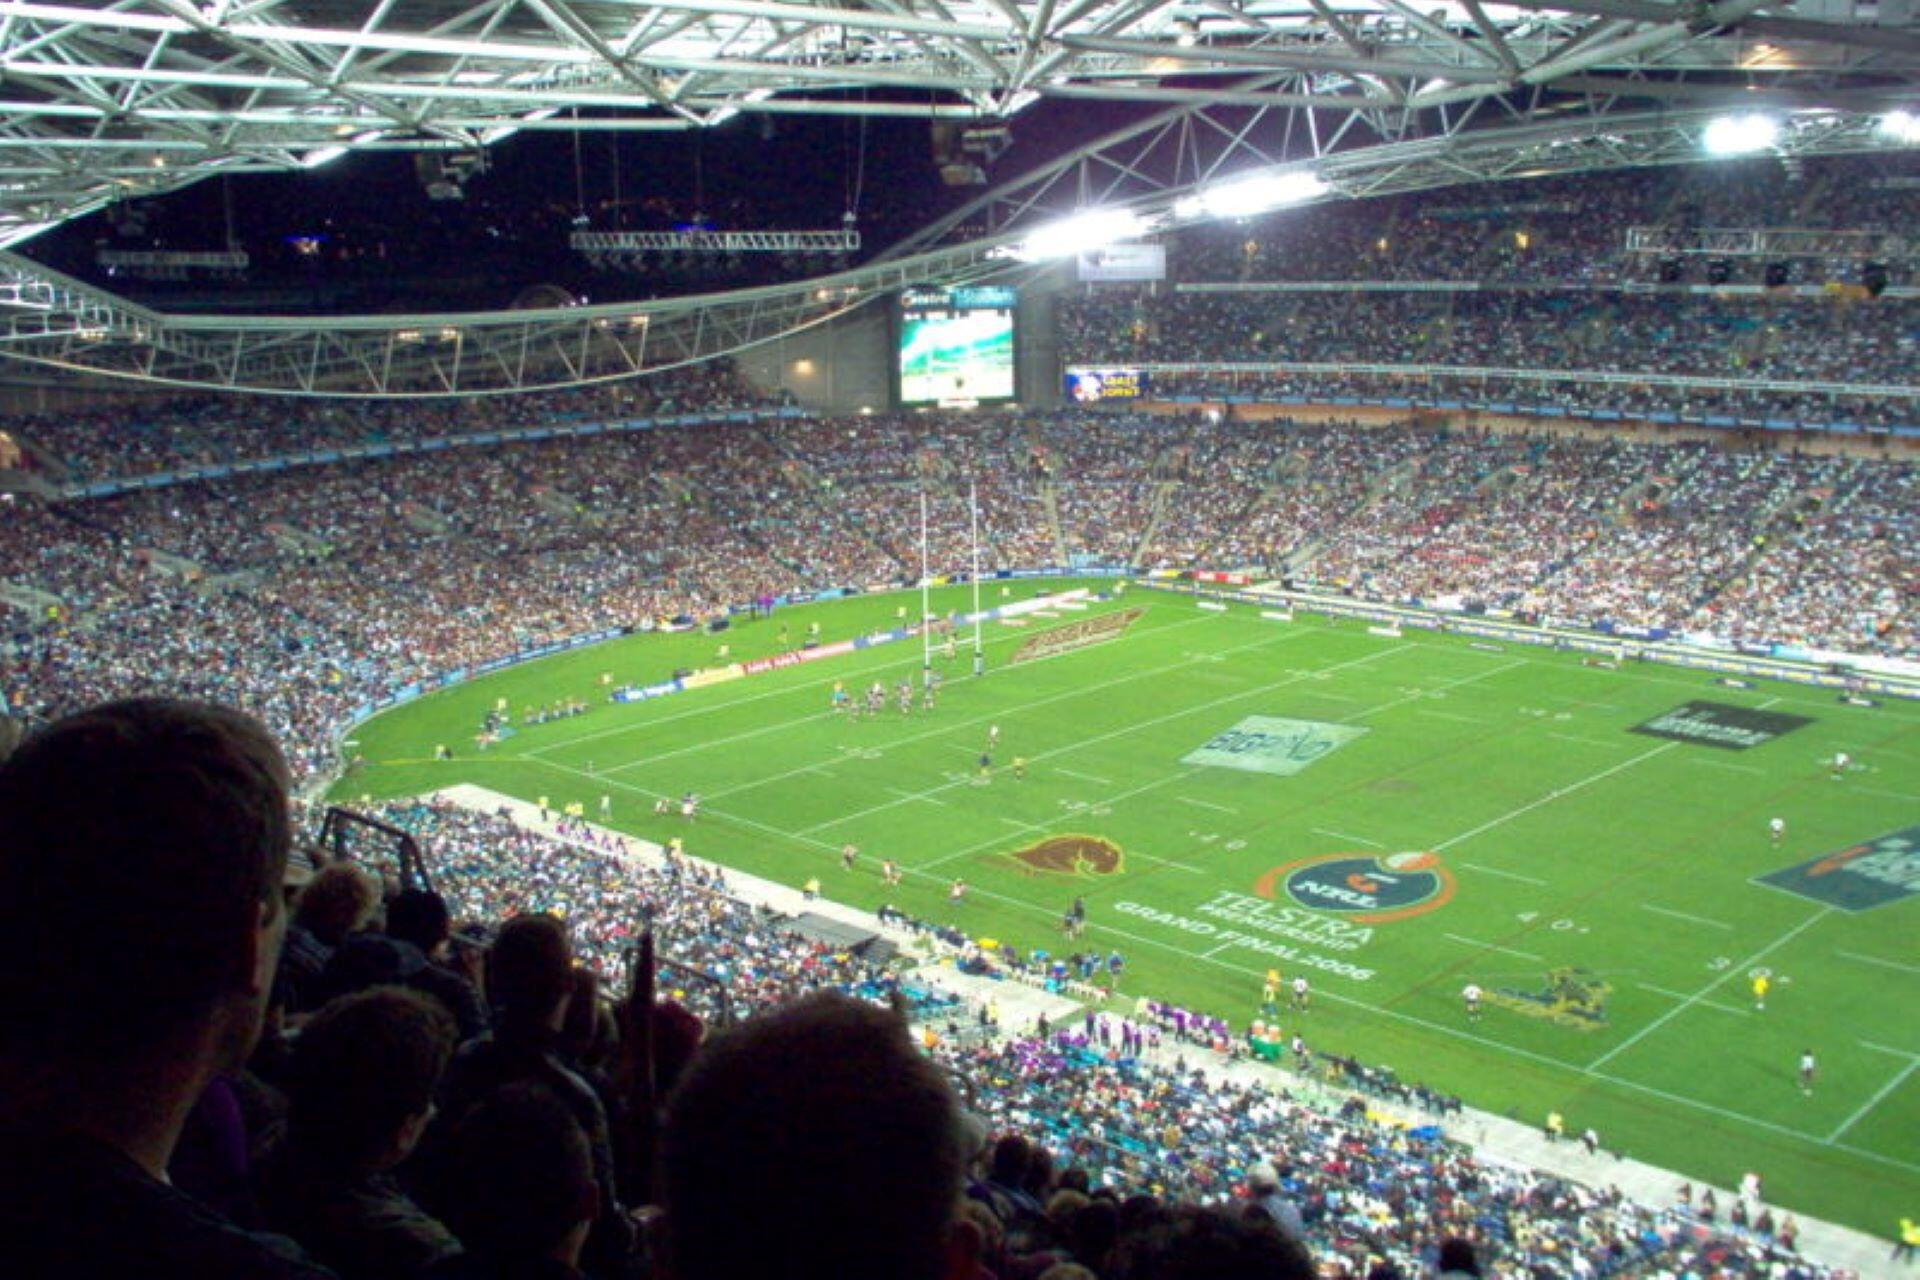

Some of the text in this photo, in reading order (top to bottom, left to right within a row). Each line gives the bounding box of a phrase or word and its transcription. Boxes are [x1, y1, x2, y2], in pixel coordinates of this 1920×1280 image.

[1210, 891, 1374, 945] TELSTRA
[1293, 880, 1378, 908] NRL
[1114, 901, 1375, 981] GRAND FINAL 2006
